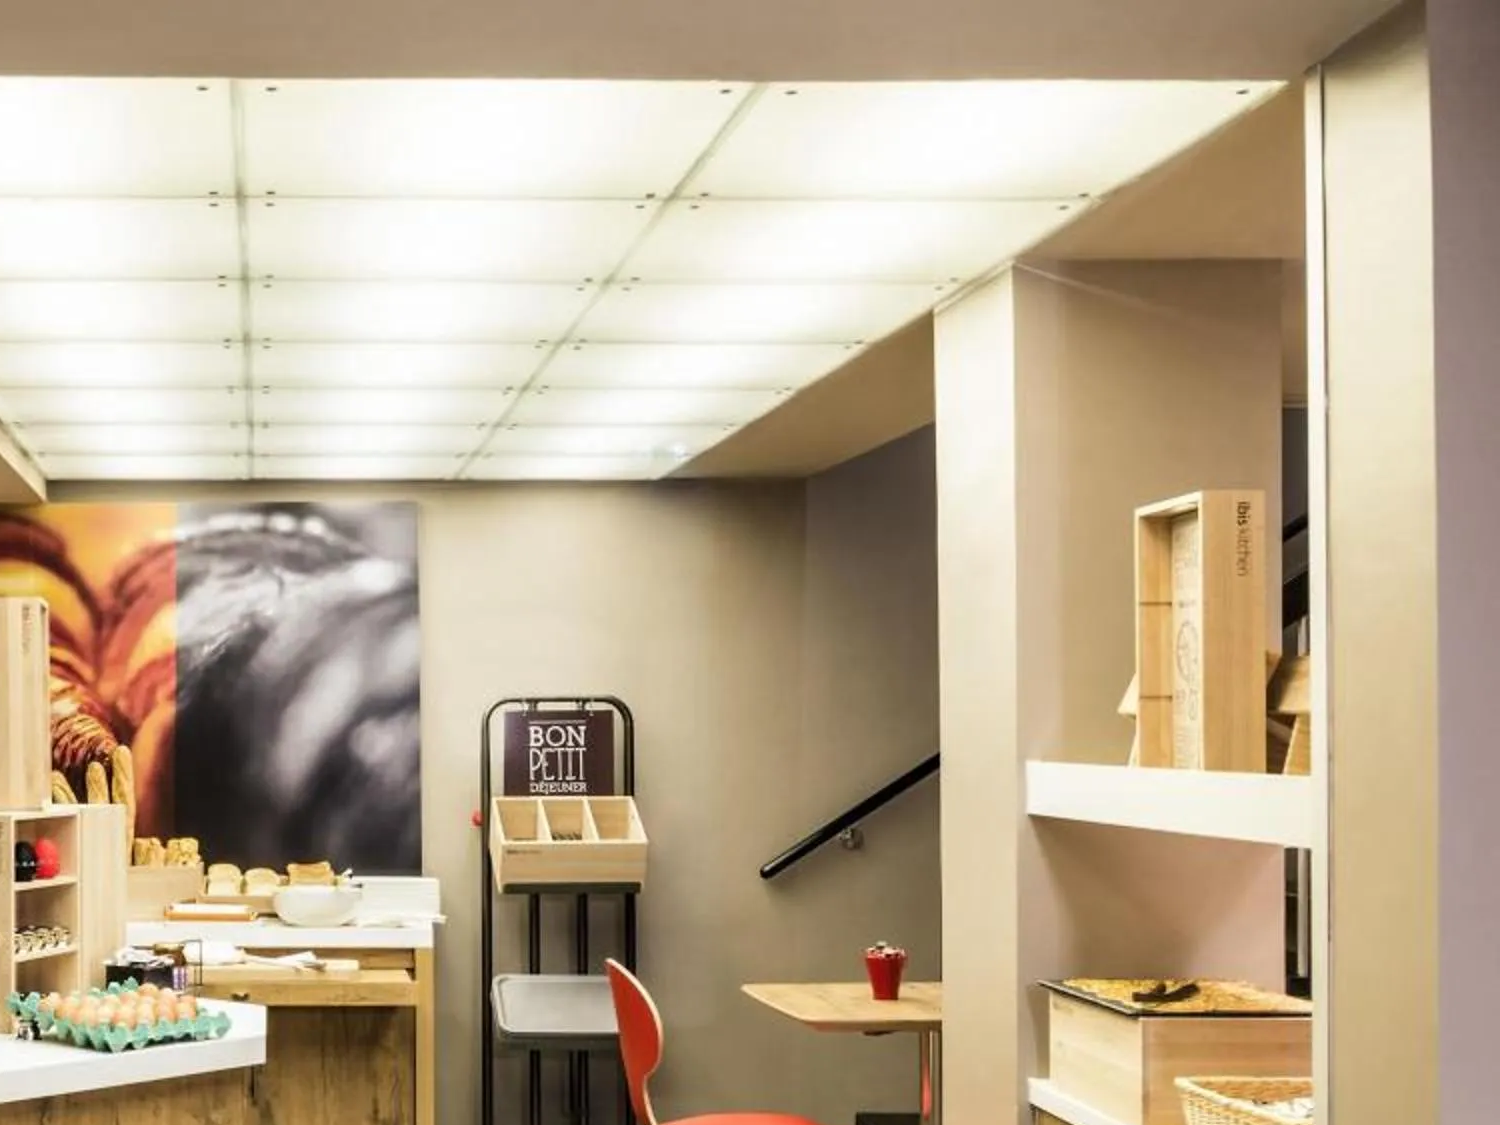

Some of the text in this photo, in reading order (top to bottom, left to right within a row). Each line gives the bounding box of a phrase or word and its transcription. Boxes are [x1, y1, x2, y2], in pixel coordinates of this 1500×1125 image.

[529, 726, 586, 747] BON
[529, 748, 587, 780] PETIT
[530, 781, 587, 794] DÉJEUNER
